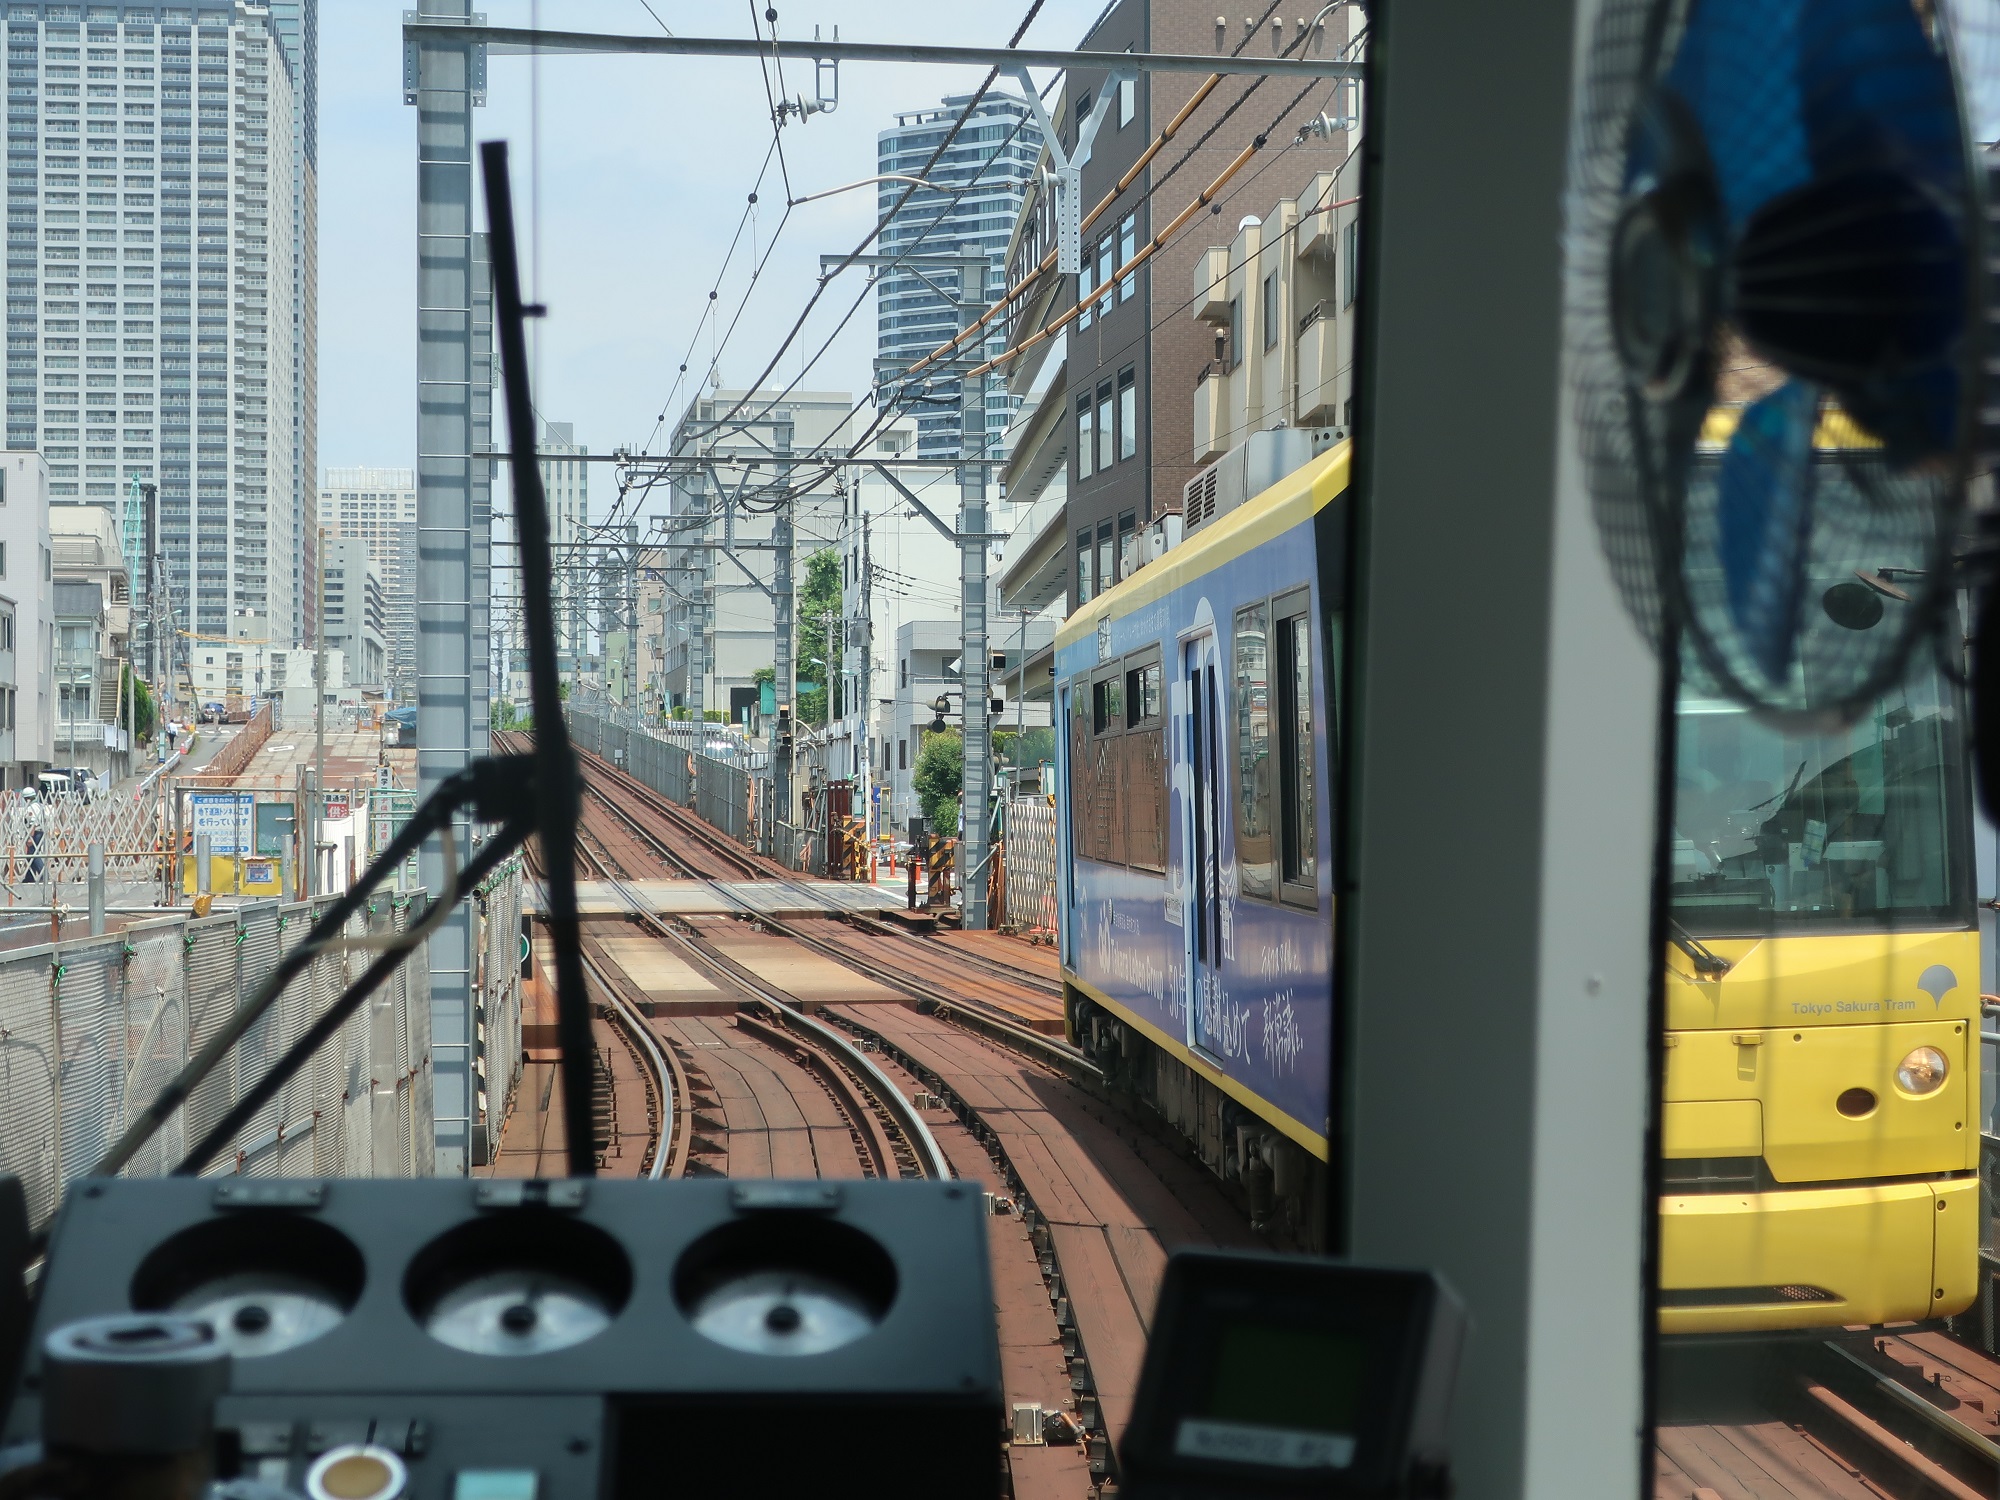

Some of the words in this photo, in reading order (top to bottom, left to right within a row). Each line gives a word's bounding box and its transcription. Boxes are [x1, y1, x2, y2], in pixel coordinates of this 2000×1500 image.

[1146, 955, 1164, 1010] Group
[1791, 1002, 1832, 1016] Tokyo
[1835, 1000, 1881, 1013] Sakura
[1883, 999, 1916, 1011] Tram
